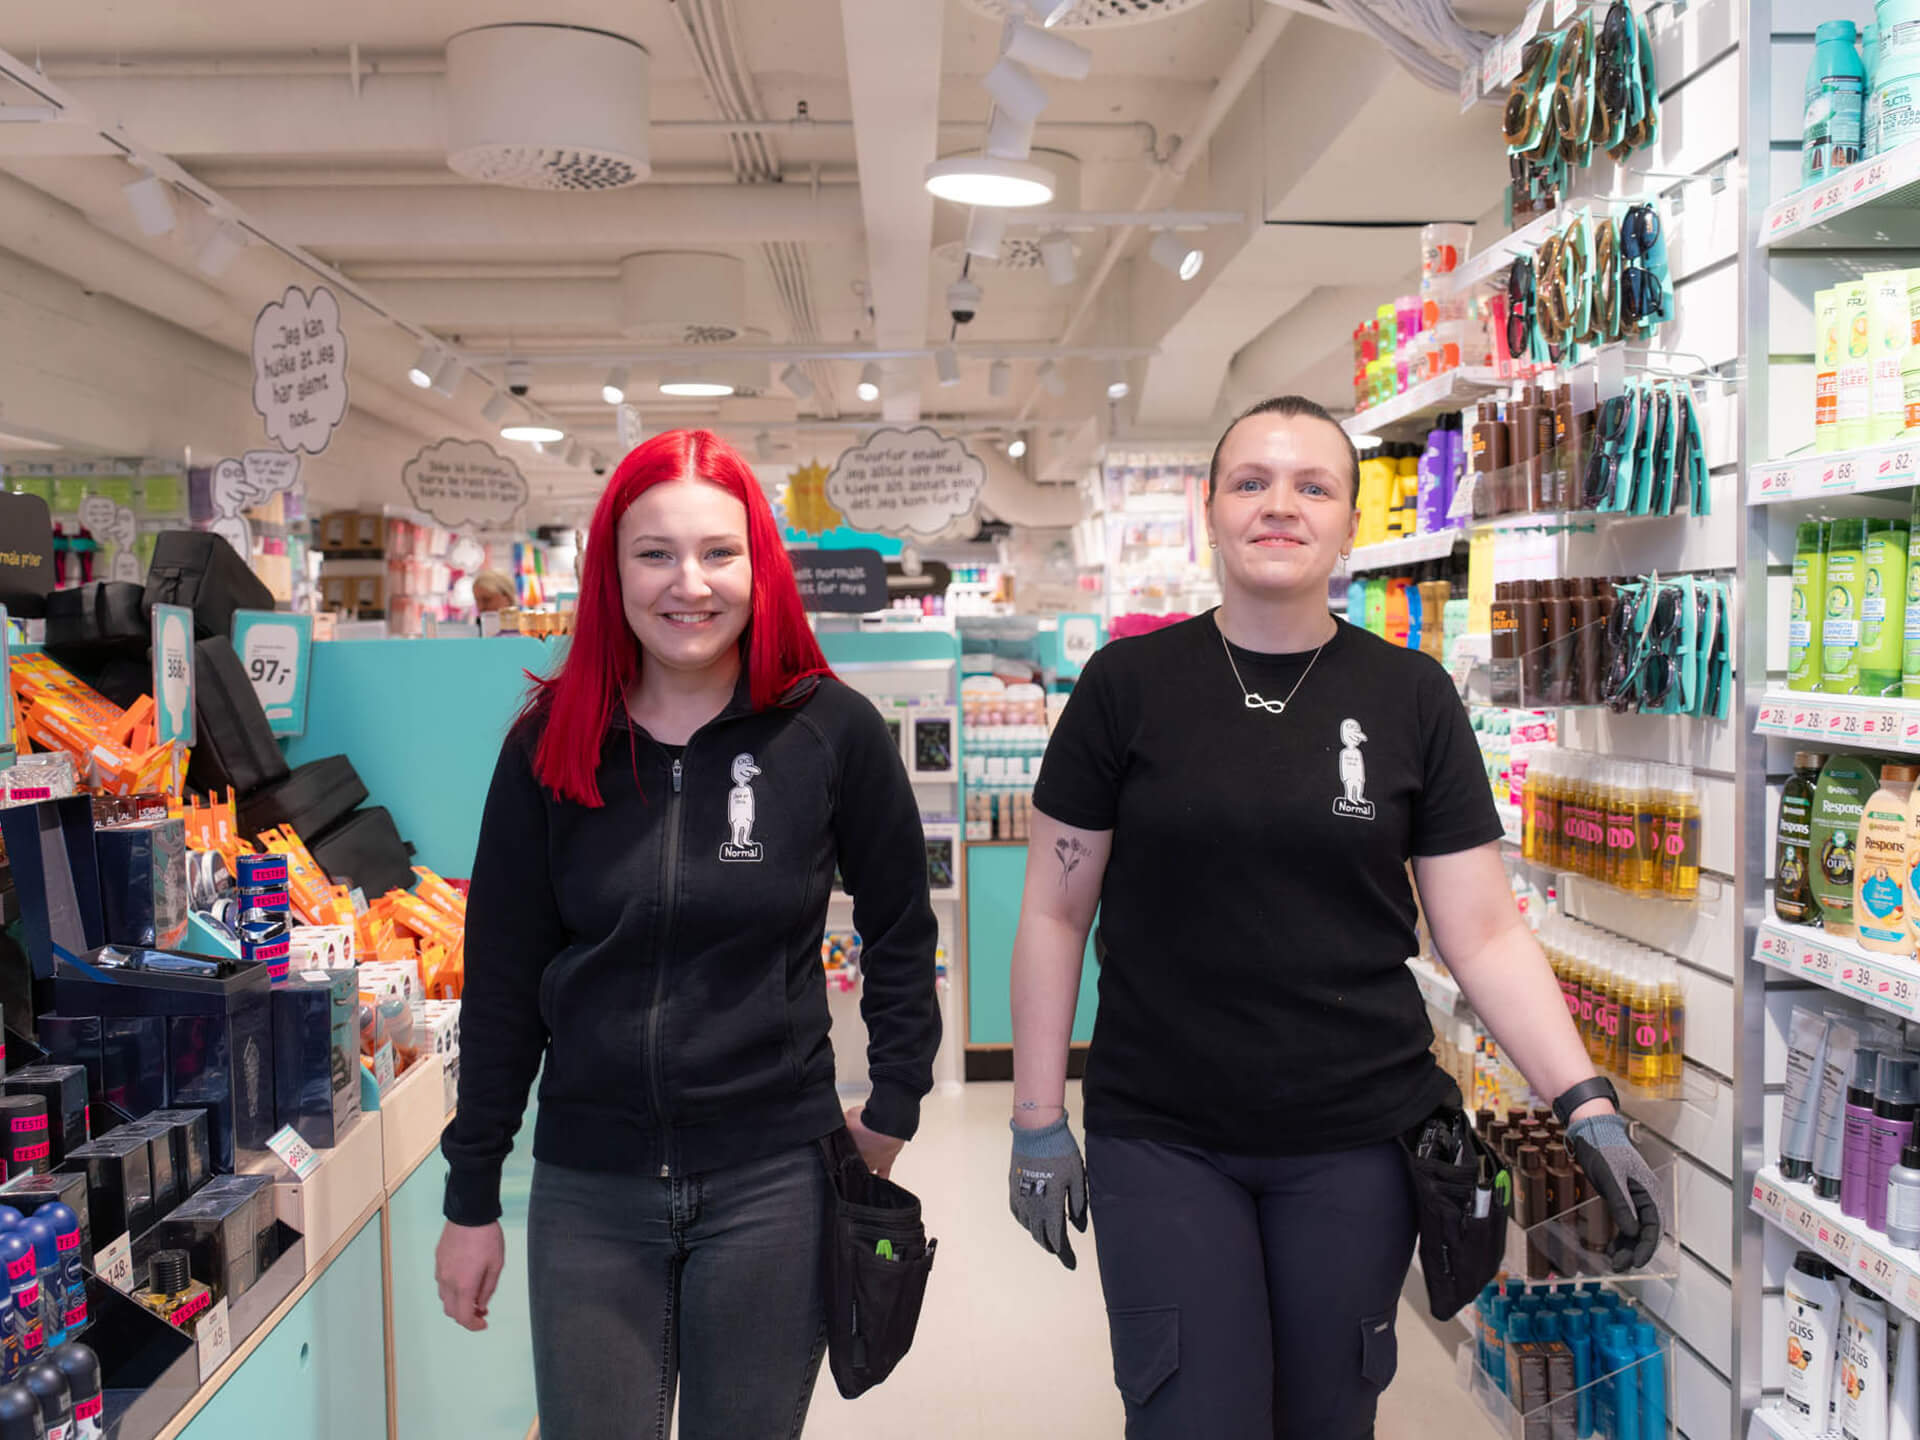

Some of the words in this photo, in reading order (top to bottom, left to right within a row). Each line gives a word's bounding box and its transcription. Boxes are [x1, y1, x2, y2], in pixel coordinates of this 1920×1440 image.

[13, 789, 49, 799] TESTER
[1339, 801, 1371, 815] Normal
[1823, 800, 1865, 817] Respons
[725, 846, 758, 858] Normal
[1864, 837, 1905, 854] Respons
[255, 868, 285, 879] TESTER
[256, 893, 286, 905] TESTER
[174, 1295, 209, 1321] TESTER
[1789, 1320, 1814, 1341] GLISS
